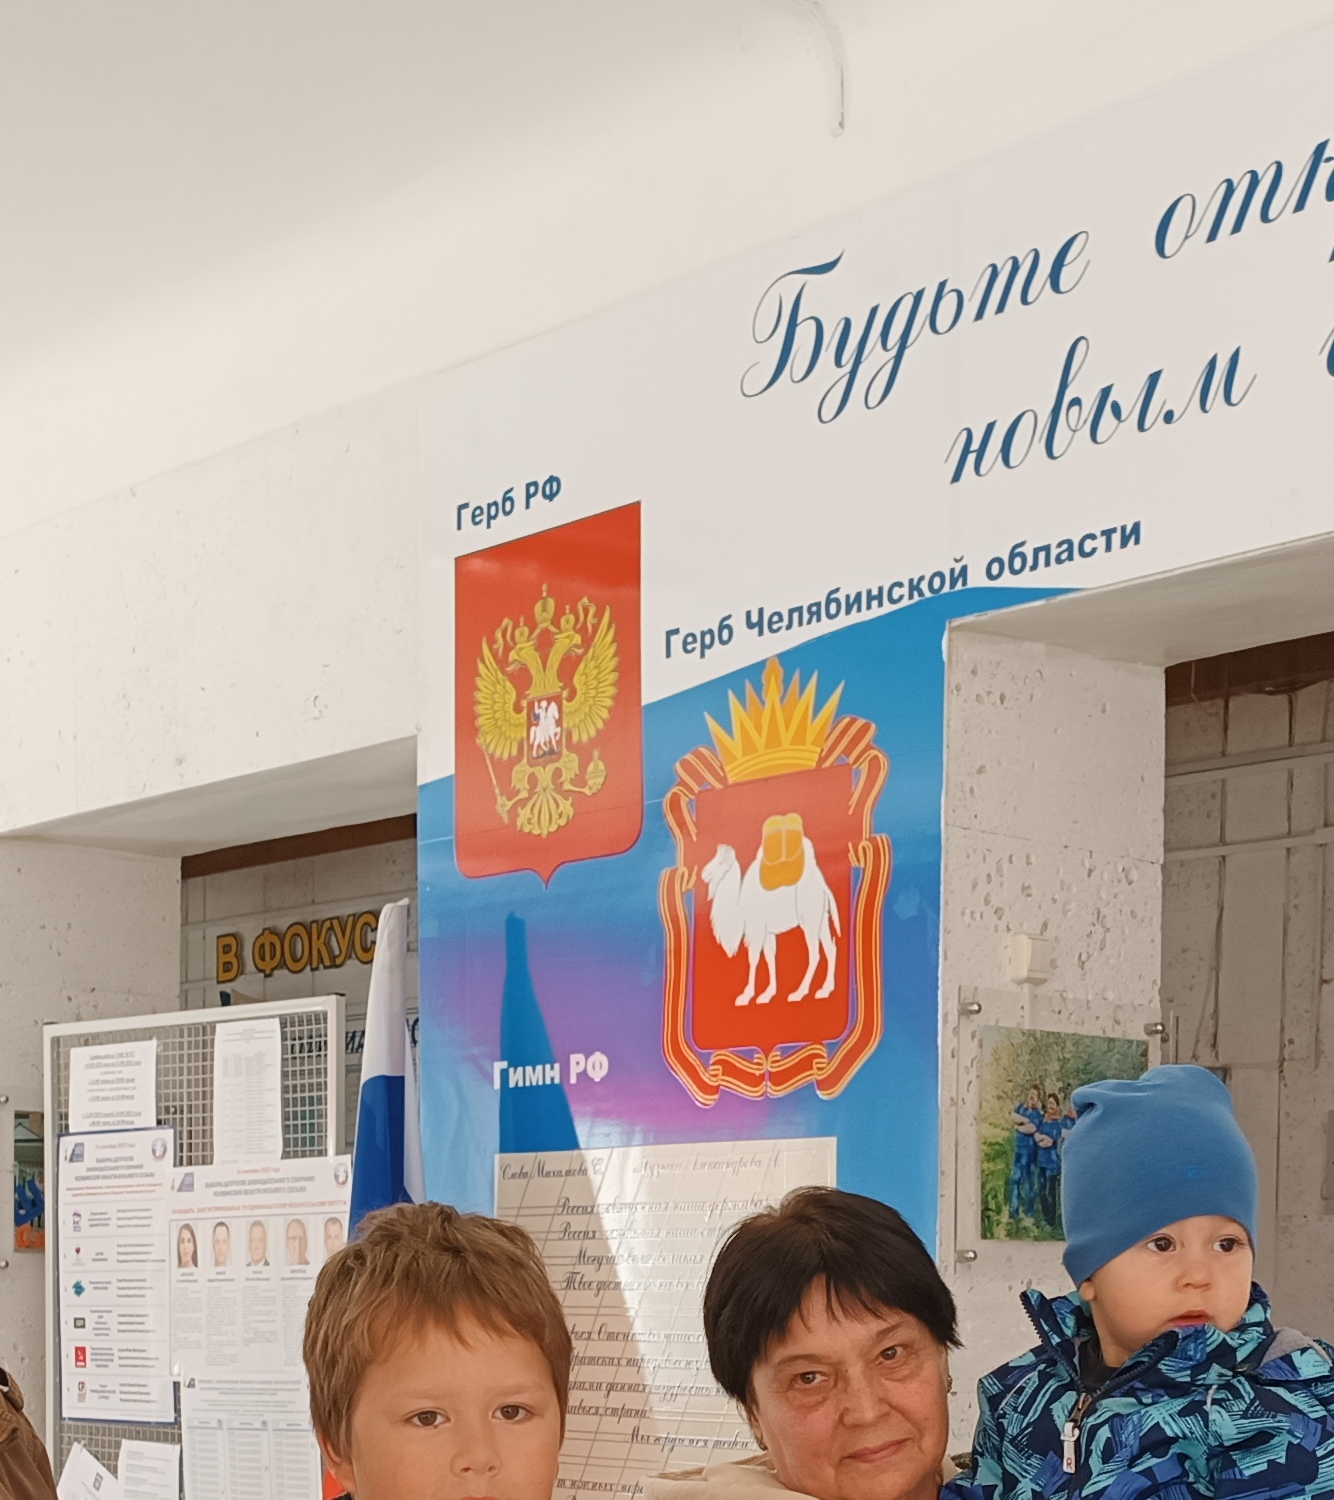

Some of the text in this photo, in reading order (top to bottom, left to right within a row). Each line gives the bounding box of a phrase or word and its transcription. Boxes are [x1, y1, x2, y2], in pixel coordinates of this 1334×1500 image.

[741, 228, 1091, 418] Будьте
[944, 348, 1257, 484] новым
[455, 474, 562, 531] Герб РФ
[665, 520, 1143, 659] Герб Челябинской области
[216, 932, 242, 984] В
[492, 1050, 610, 1091] Гимн РФ
